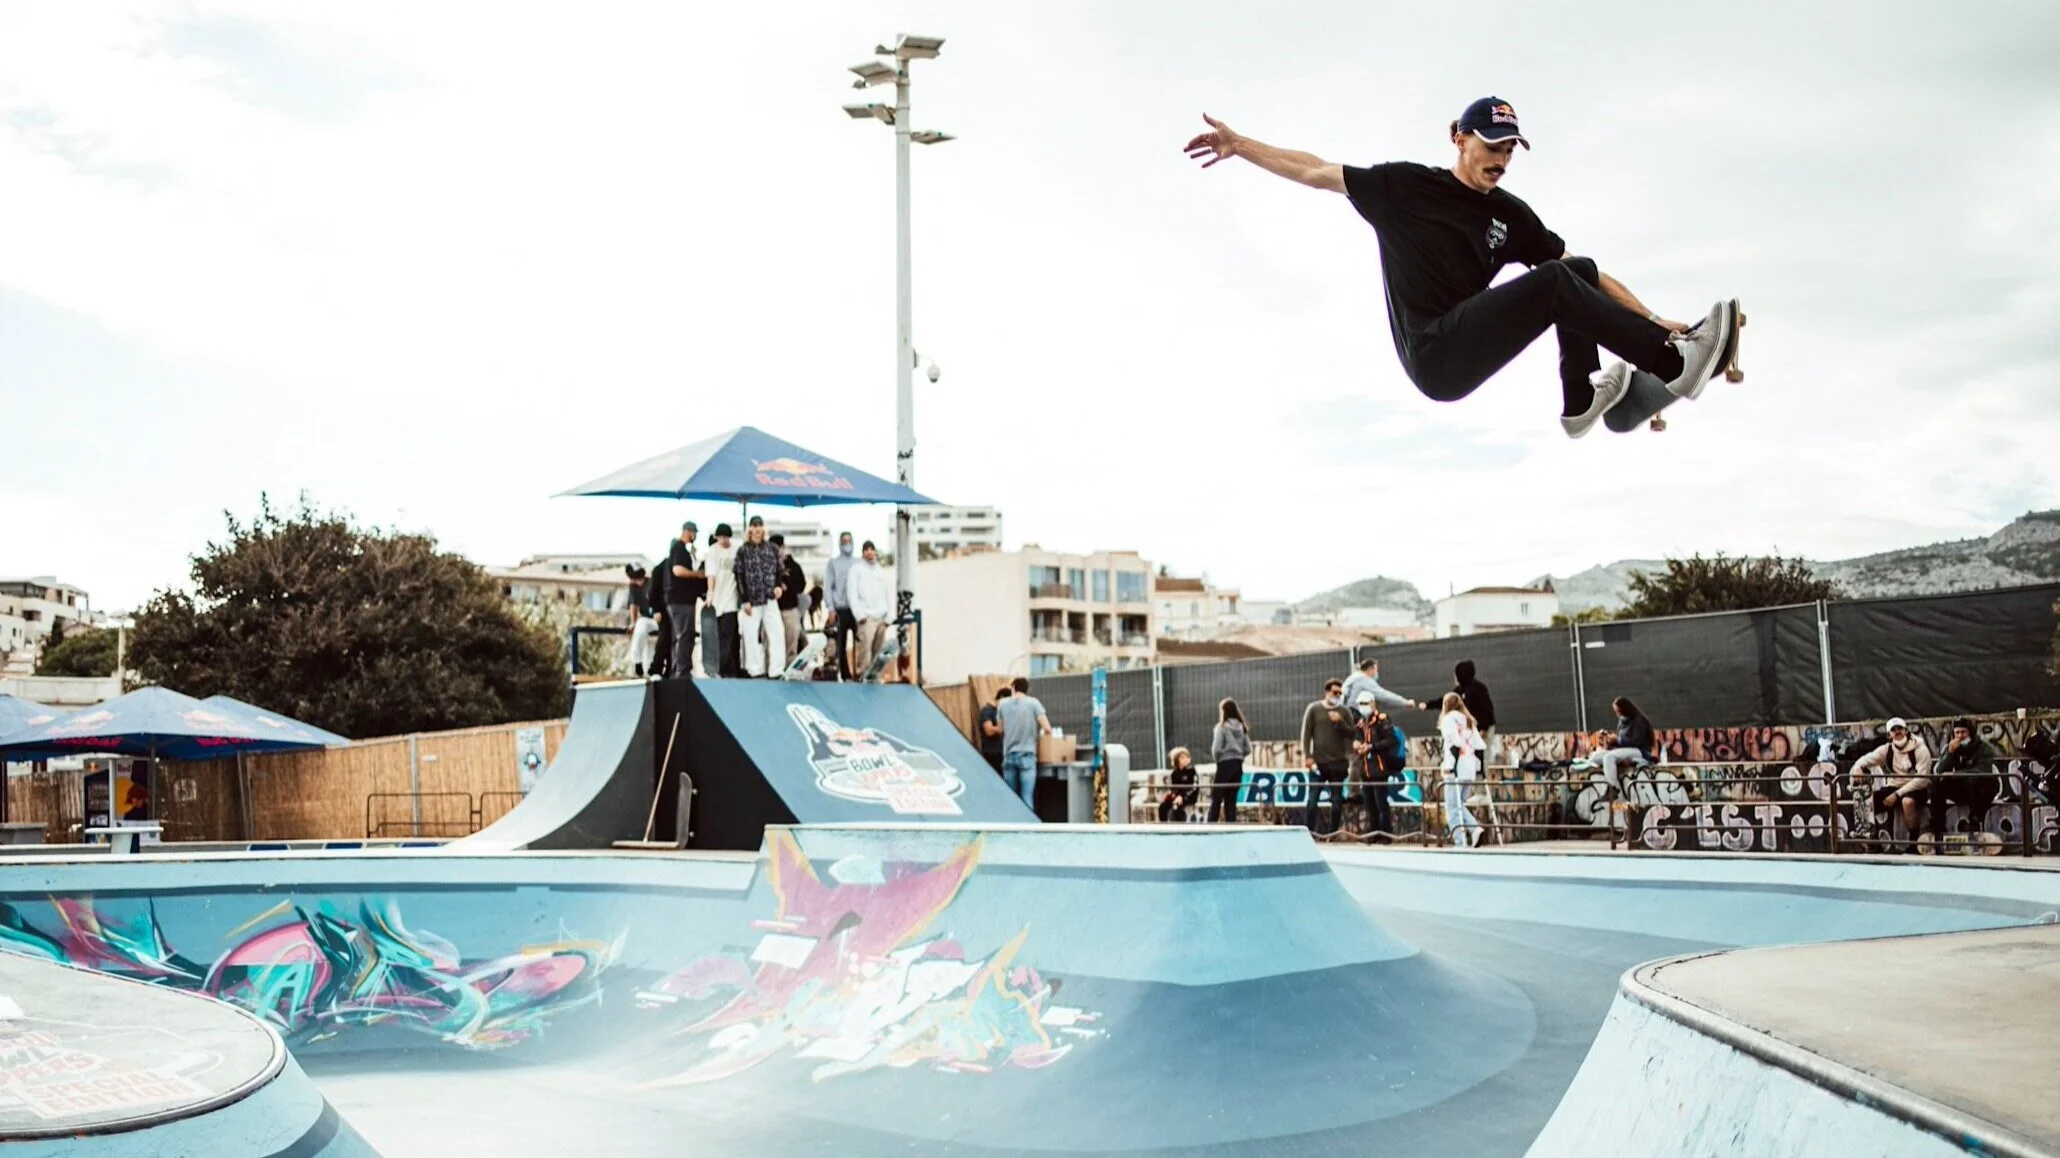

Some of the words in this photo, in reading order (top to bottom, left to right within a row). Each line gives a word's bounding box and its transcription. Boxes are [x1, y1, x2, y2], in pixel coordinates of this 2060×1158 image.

[849, 753, 894, 773] BOWL
[26, 1071, 176, 1099] SPECIAL
[42, 1081, 194, 1109] EDITION
